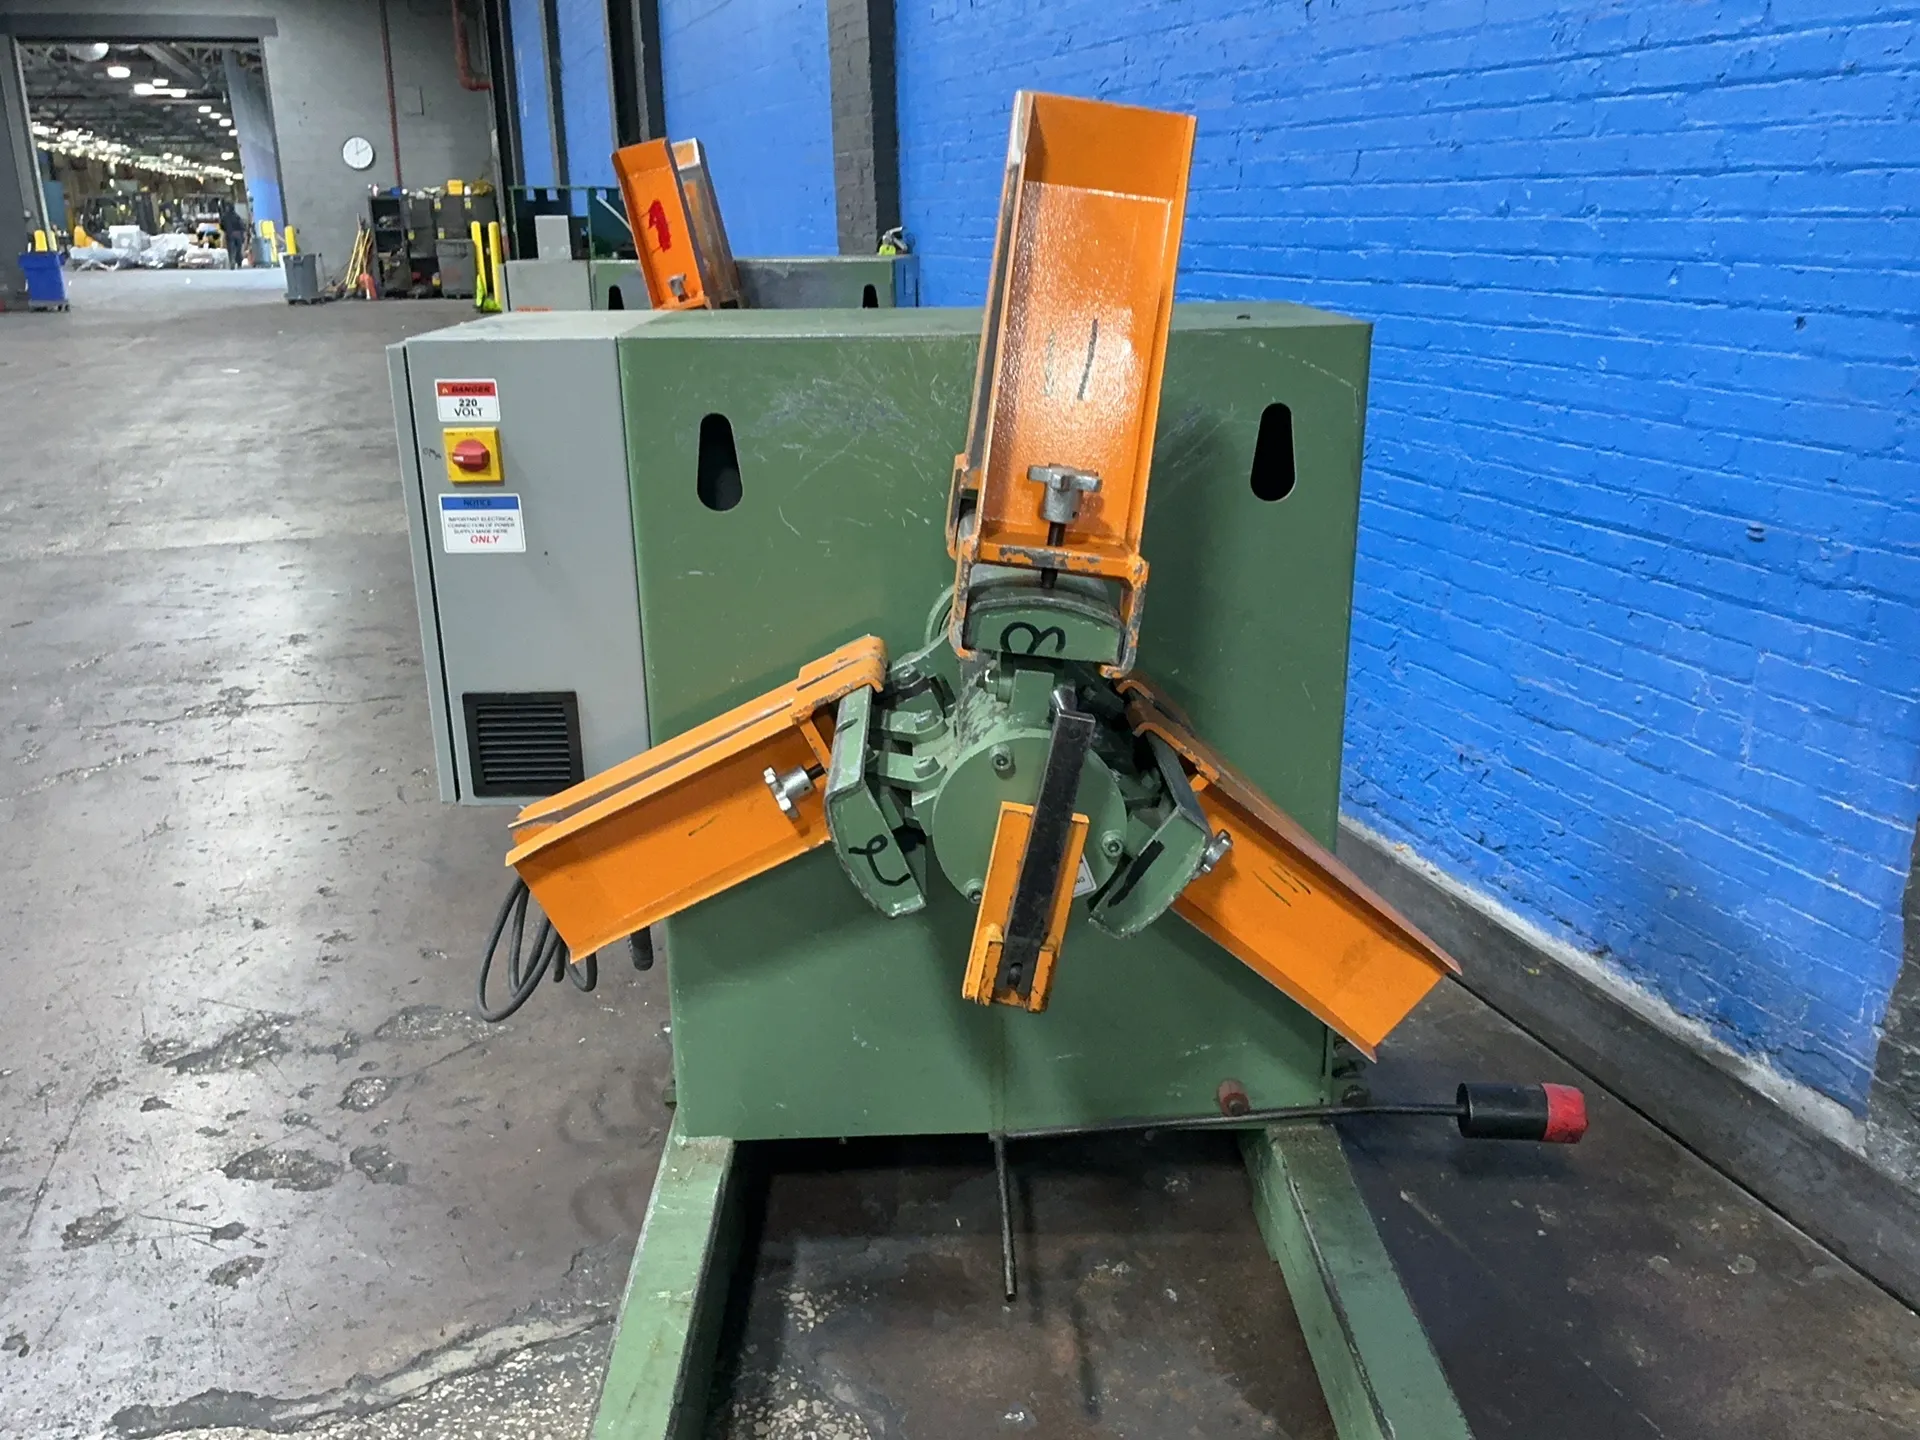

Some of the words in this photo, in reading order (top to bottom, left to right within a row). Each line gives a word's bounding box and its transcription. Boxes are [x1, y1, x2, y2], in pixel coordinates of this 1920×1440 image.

[451, 385, 491, 393] DANGER
[458, 398, 478, 407] 220
[454, 407, 482, 417] VOLT
[463, 499, 492, 507] NOTICE
[470, 534, 500, 544] ONLY
